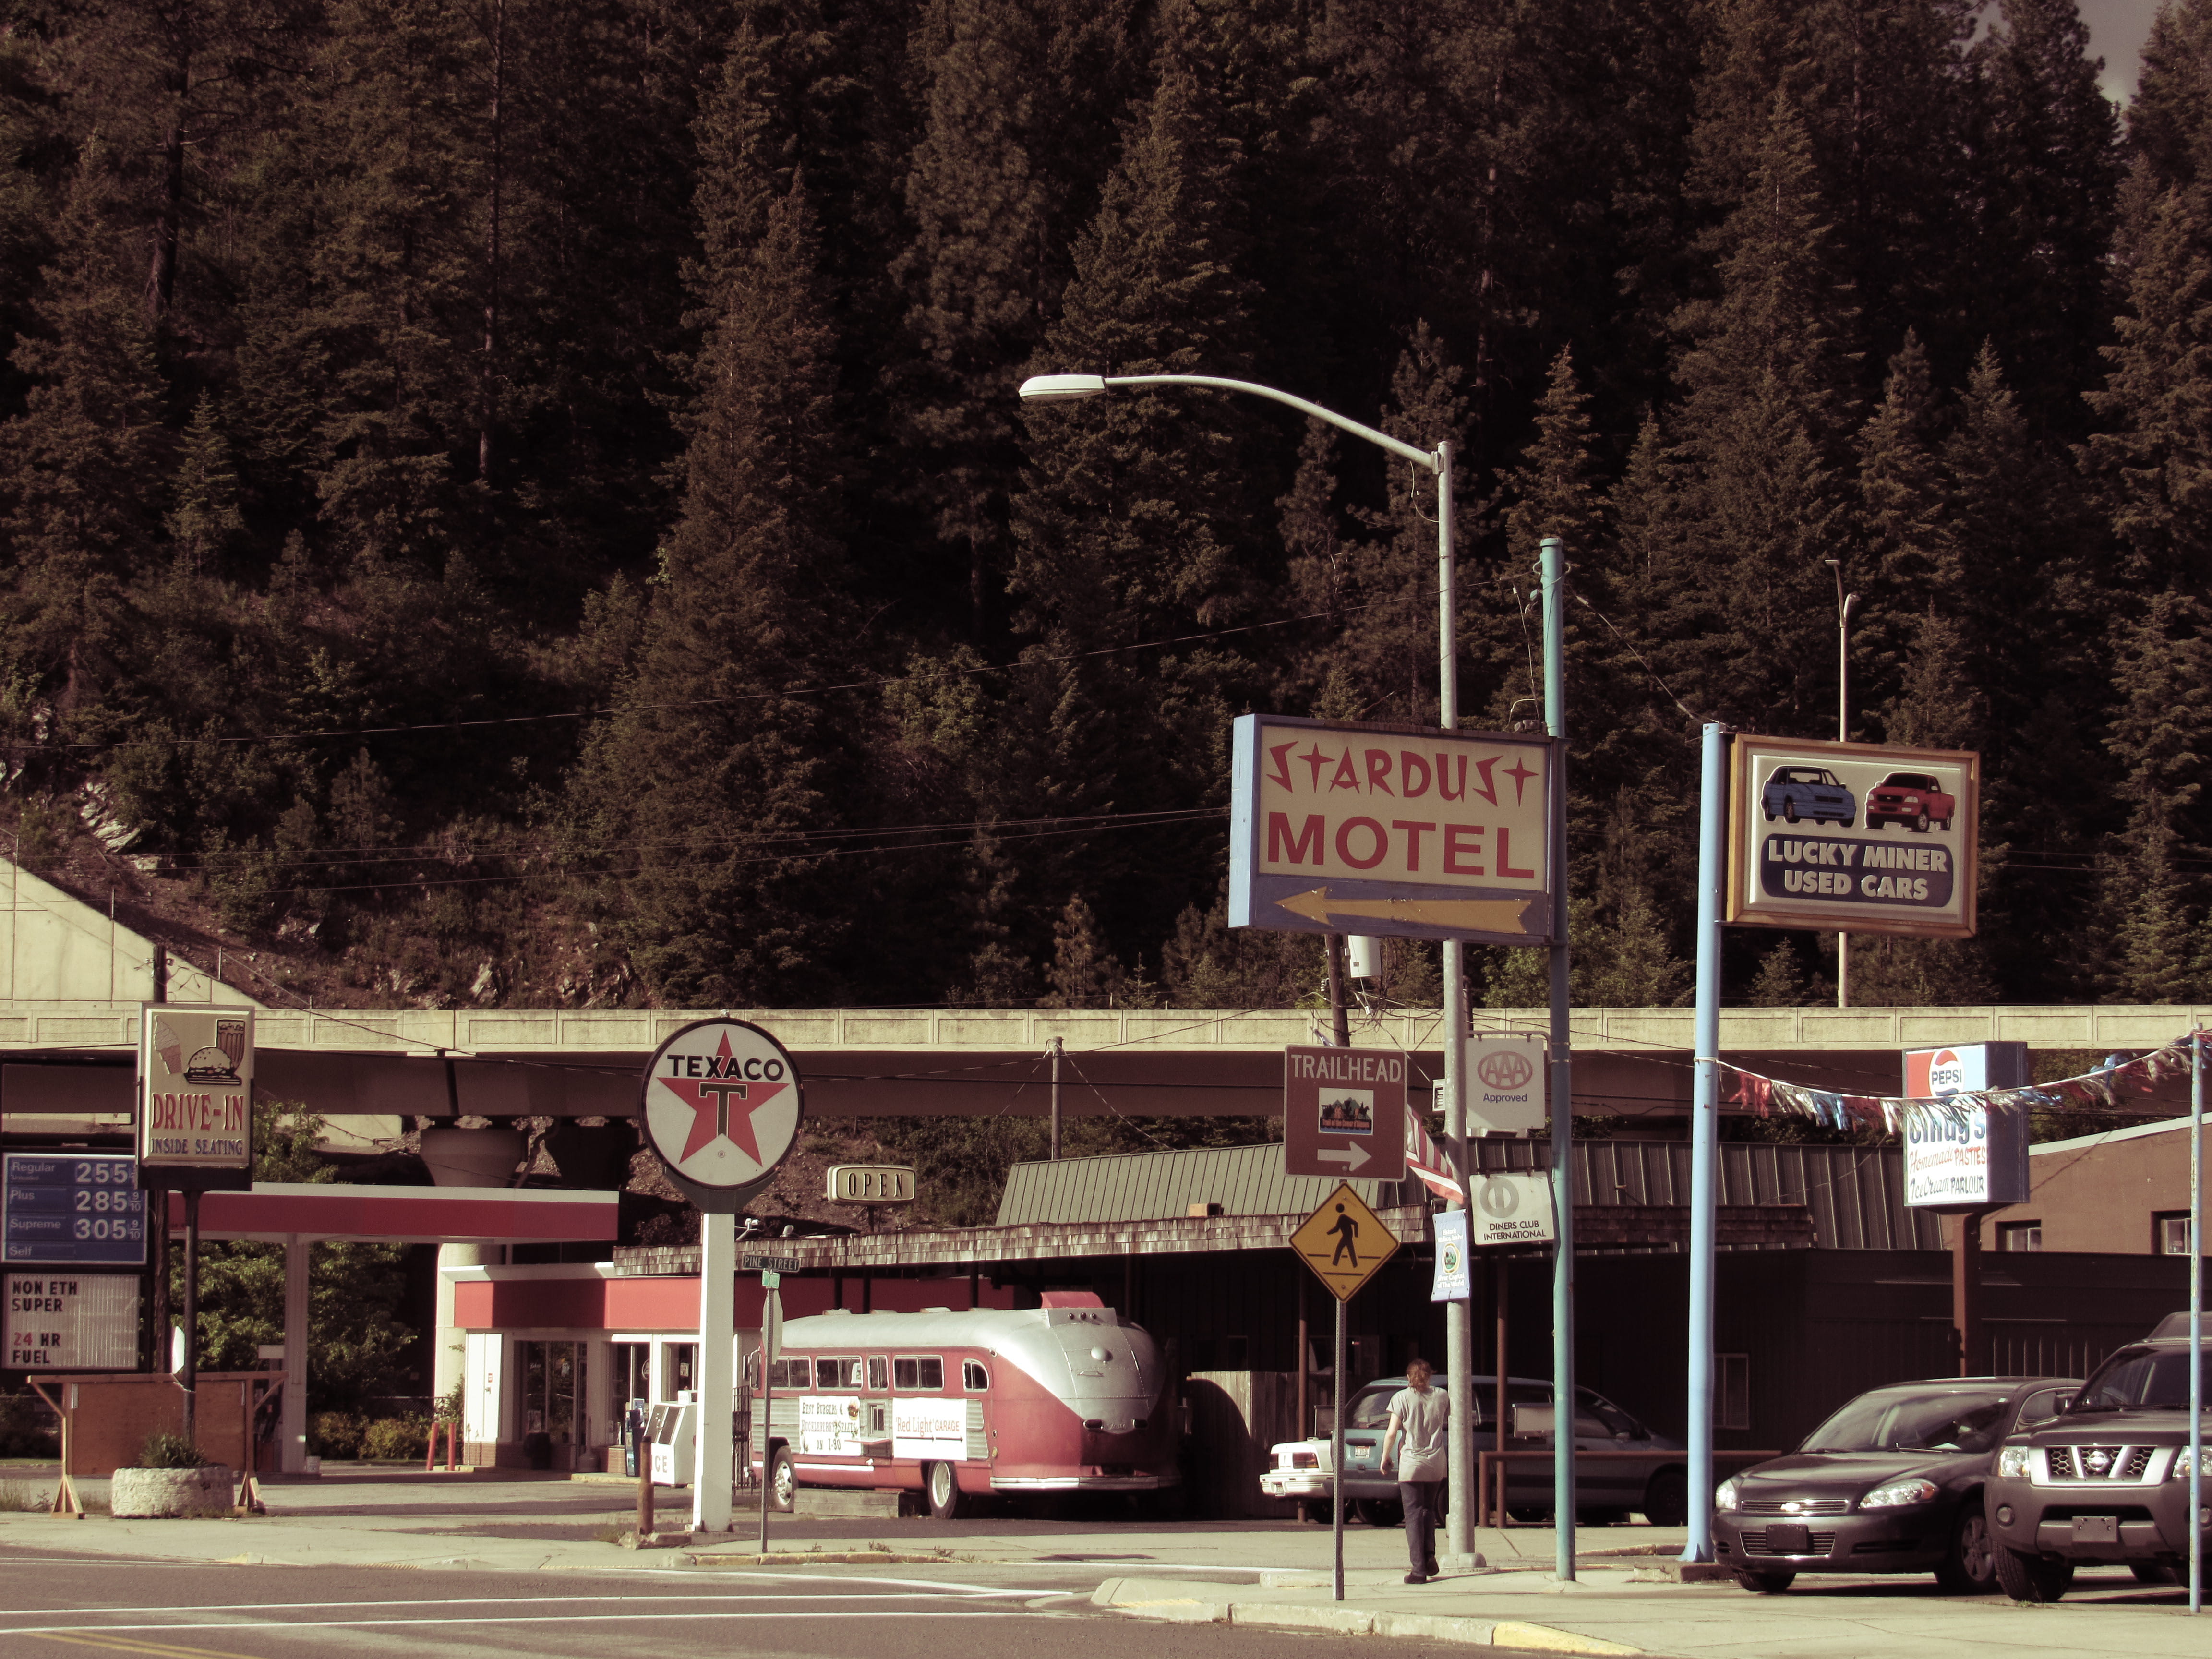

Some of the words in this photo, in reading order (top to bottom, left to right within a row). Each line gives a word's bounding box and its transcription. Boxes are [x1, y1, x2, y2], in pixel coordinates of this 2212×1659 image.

[1266, 741, 1539, 807] STARDUST
[1267, 811, 1535, 879] MOTEL
[1768, 839, 1858, 866] LUCKY
[1862, 845, 1948, 872] MINER
[1784, 869, 1852, 895] USED
[1861, 874, 1929, 901] CARS
[667, 1054, 785, 1081] TEXACO
[1291, 1054, 1402, 1082] TRAILHEAD
[1484, 1052, 1527, 1088] AAA
[1931, 1069, 1962, 1085] PEPSI
[1483, 1093, 1528, 1104] Approved
[152, 1092, 244, 1131] DRIVE-IN
[151, 1137, 189, 1154] INSIDE
[195, 1138, 242, 1155] SEATING
[1910, 1146, 1953, 1174] Homemade
[12, 1161, 56, 1174] Regular
[76, 1162, 129, 1183] 255
[847, 1172, 903, 1198] OPEN
[1950, 1175, 1984, 1196] PARLOUR
[11, 1190, 35, 1200] Plus
[76, 1190, 128, 1211] 285
[10, 1218, 61, 1230] Supreme
[75, 1218, 127, 1239] 305
[1483, 1229, 1546, 1241] INTERNATIONAL
[1489, 1221, 1517, 1231] DINERS
[1519, 1220, 1539, 1229] CLUB
[9, 1246, 33, 1256] Self
[744, 1255, 762, 1268] PINE
[768, 1257, 798, 1270] STREET
[12, 1281, 43, 1295] NON
[49, 1281, 78, 1295] ETH
[12, 1298, 63, 1312] SUPER
[13, 1332, 33, 1346] 24
[41, 1333, 60, 1346] HR
[12, 1350, 50, 1364] FUEL
[935, 1419, 960, 1432] GARAGE
